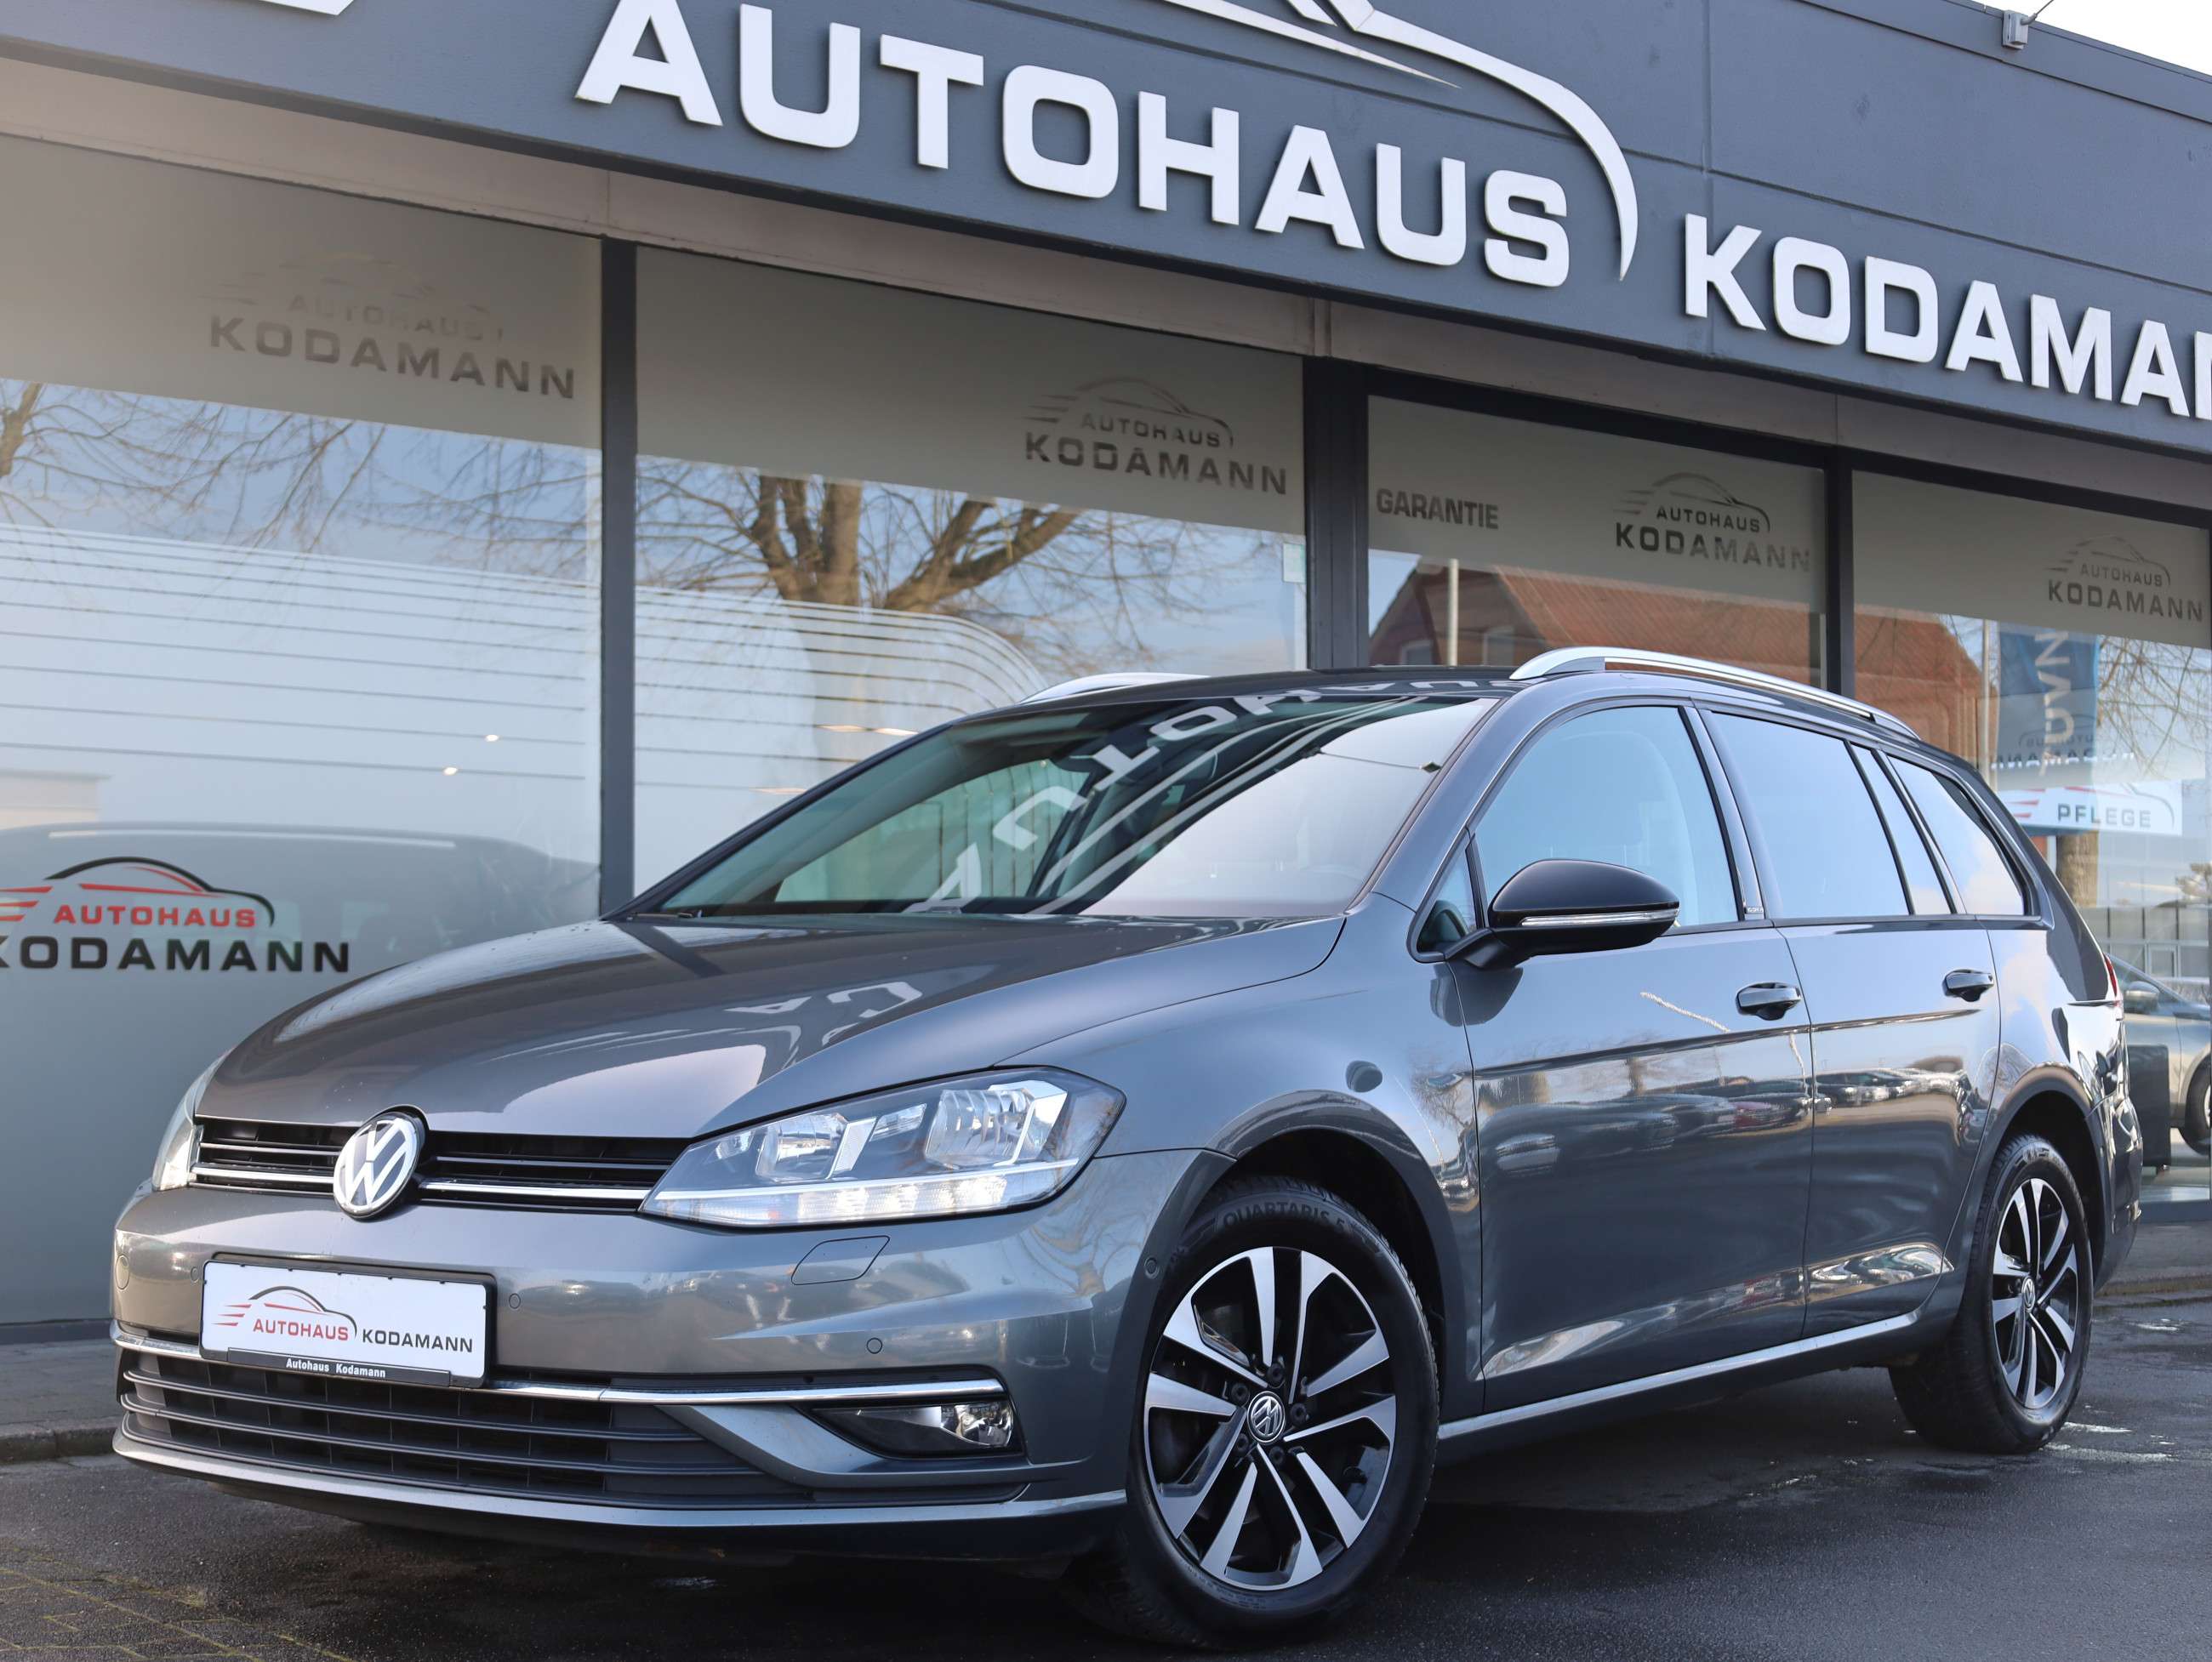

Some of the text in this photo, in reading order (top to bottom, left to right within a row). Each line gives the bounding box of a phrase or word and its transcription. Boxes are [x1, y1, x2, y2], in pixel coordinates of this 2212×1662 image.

[574, 0, 2212, 419] AUTOHAUS KODAMA
[210, 315, 574, 399] KODAMANN
[1081, 413, 1221, 448] AUTOHAUS
[1026, 432, 1286, 495] KODAMANN
[1376, 487, 1499, 530] GARANTIE
[1656, 504, 1760, 533] AUTOHAUS
[1616, 522, 1810, 572] KODAMANN
[2080, 563, 2163, 587] AUTOHAUS
[2048, 578, 2203, 622] KODAMANN
[2057, 803, 2152, 828] PFLEGE
[54, 903, 256, 929] AUTOHAUS
[253, 1318, 473, 1353] AUTOHAUS KODAMANN
[286, 1357, 386, 1378] Autohaus Kodamann
